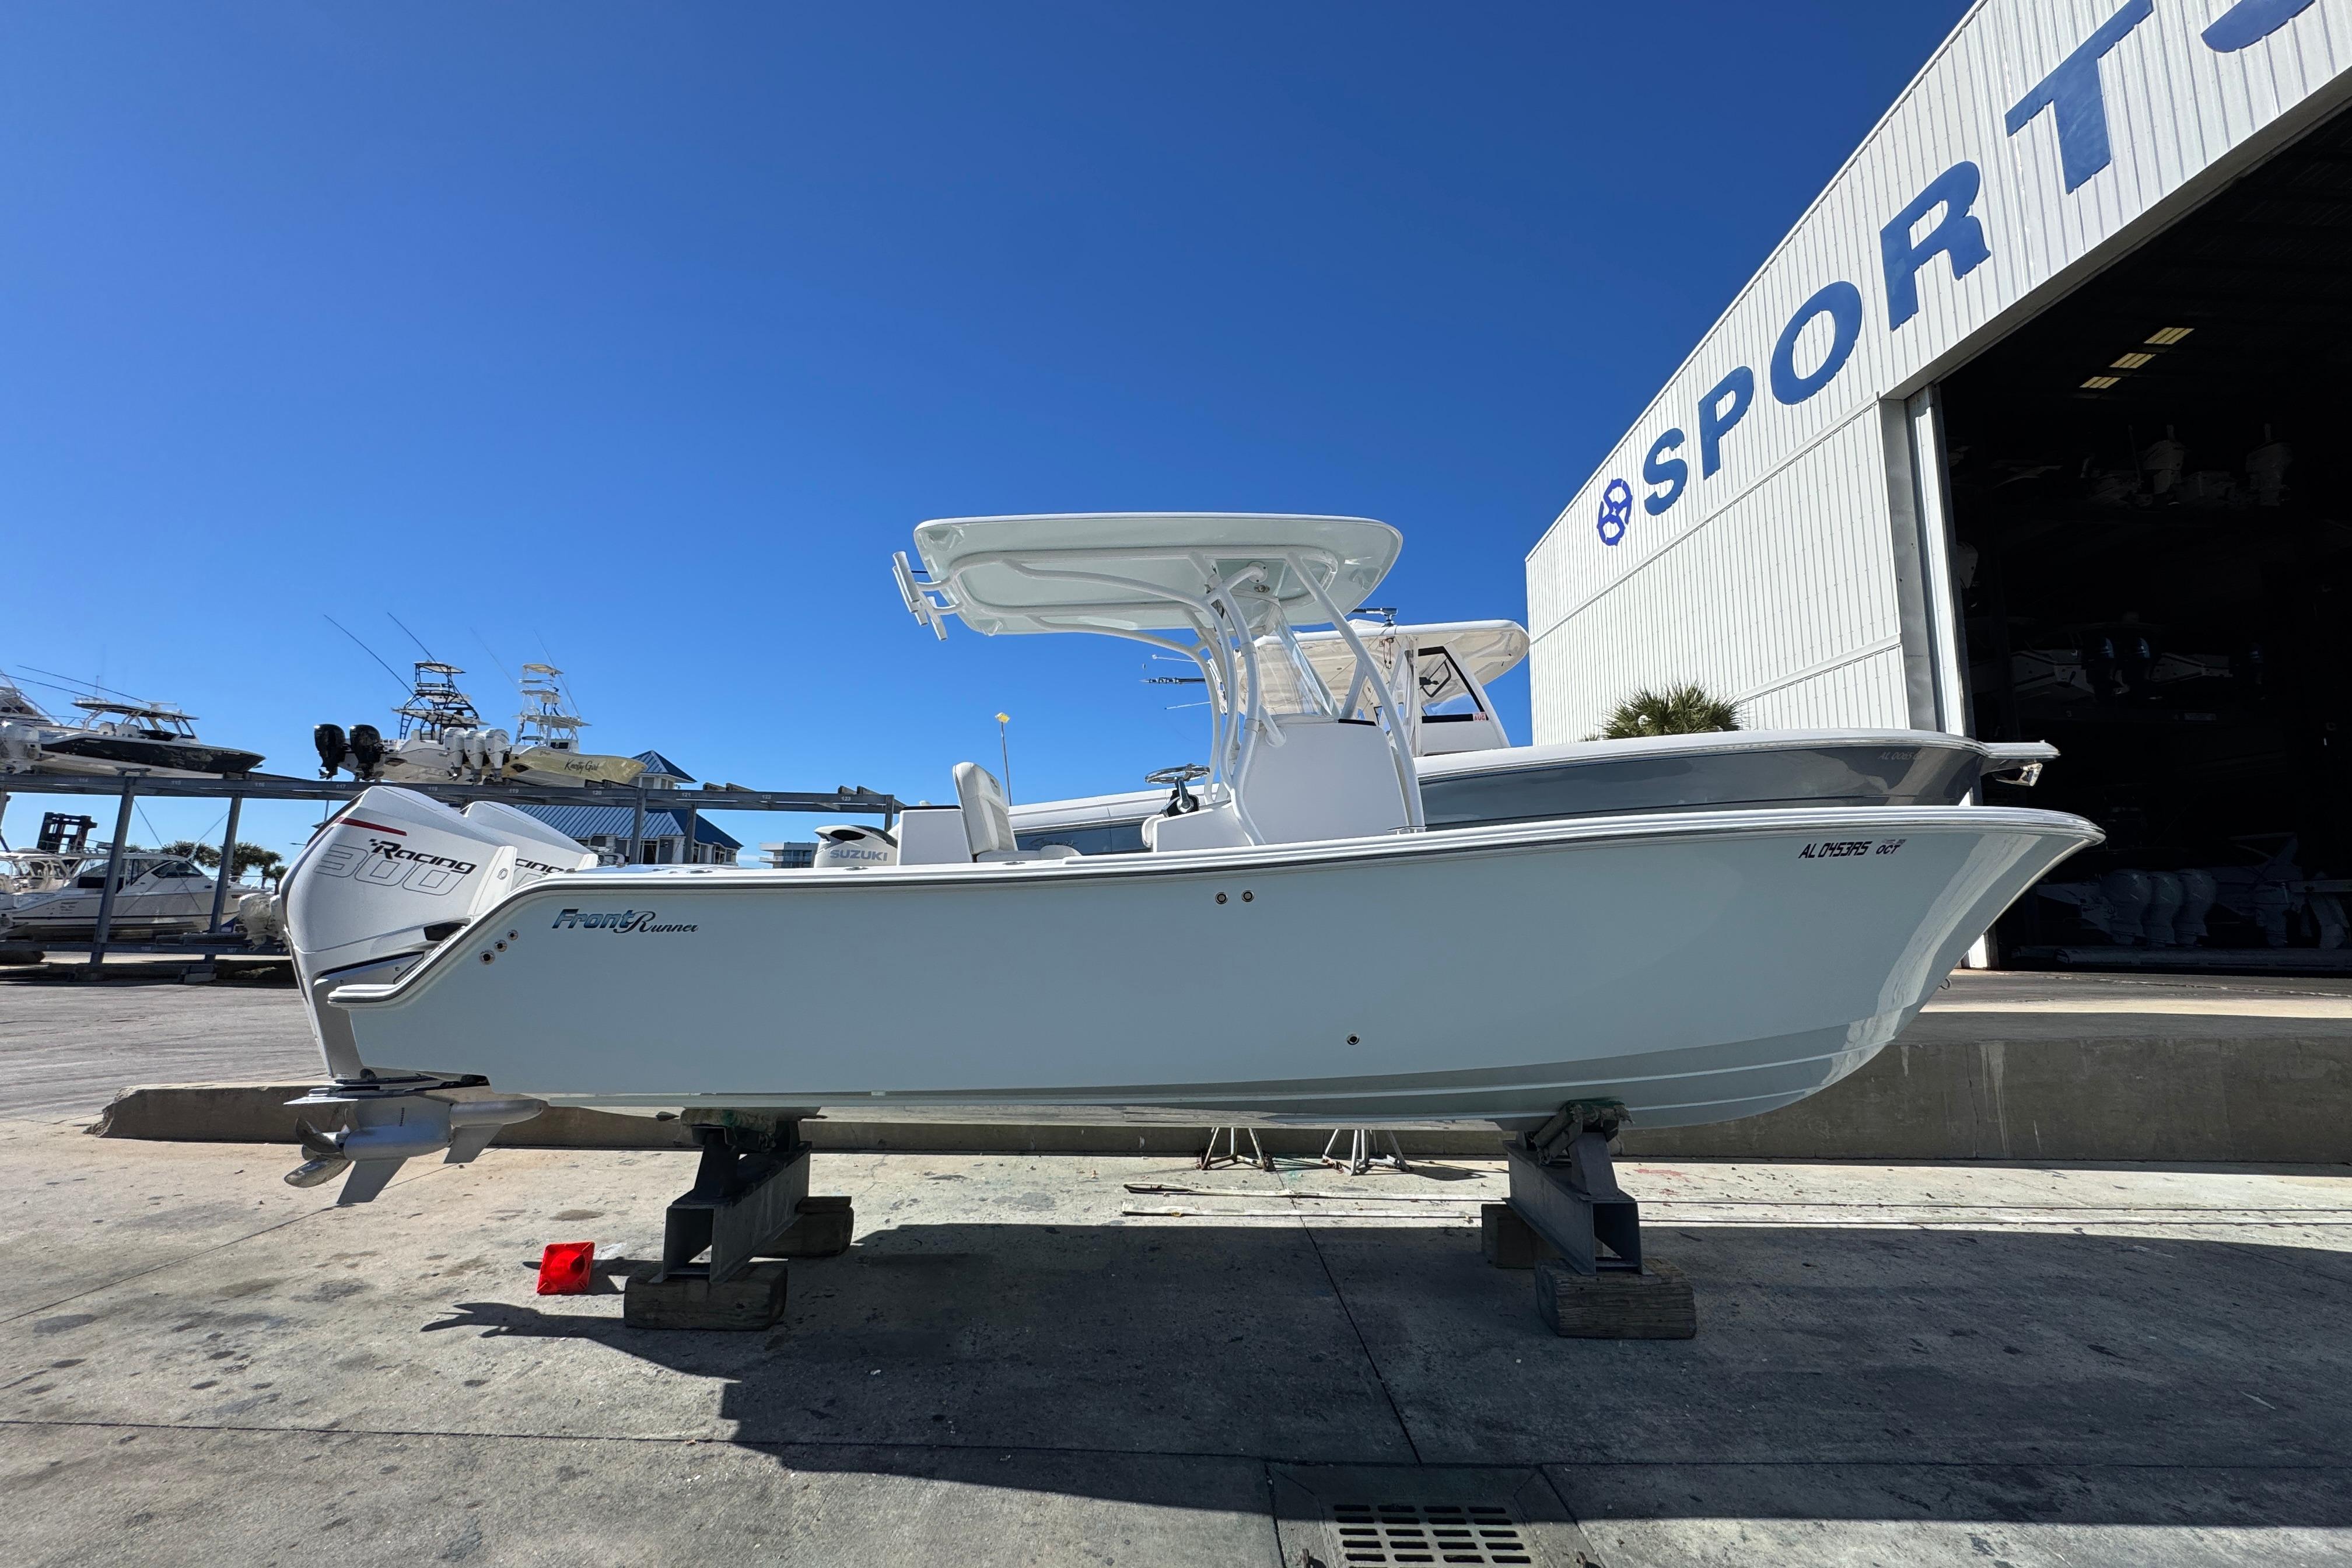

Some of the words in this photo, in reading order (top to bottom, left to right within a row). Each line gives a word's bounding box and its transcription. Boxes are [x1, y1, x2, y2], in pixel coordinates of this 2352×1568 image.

[369, 838, 477, 875] Racing
[830, 849, 888, 862] SUZUKI
[1875, 844, 1901, 855] OCT
[313, 844, 466, 896] 300
[515, 858, 565, 876] cing
